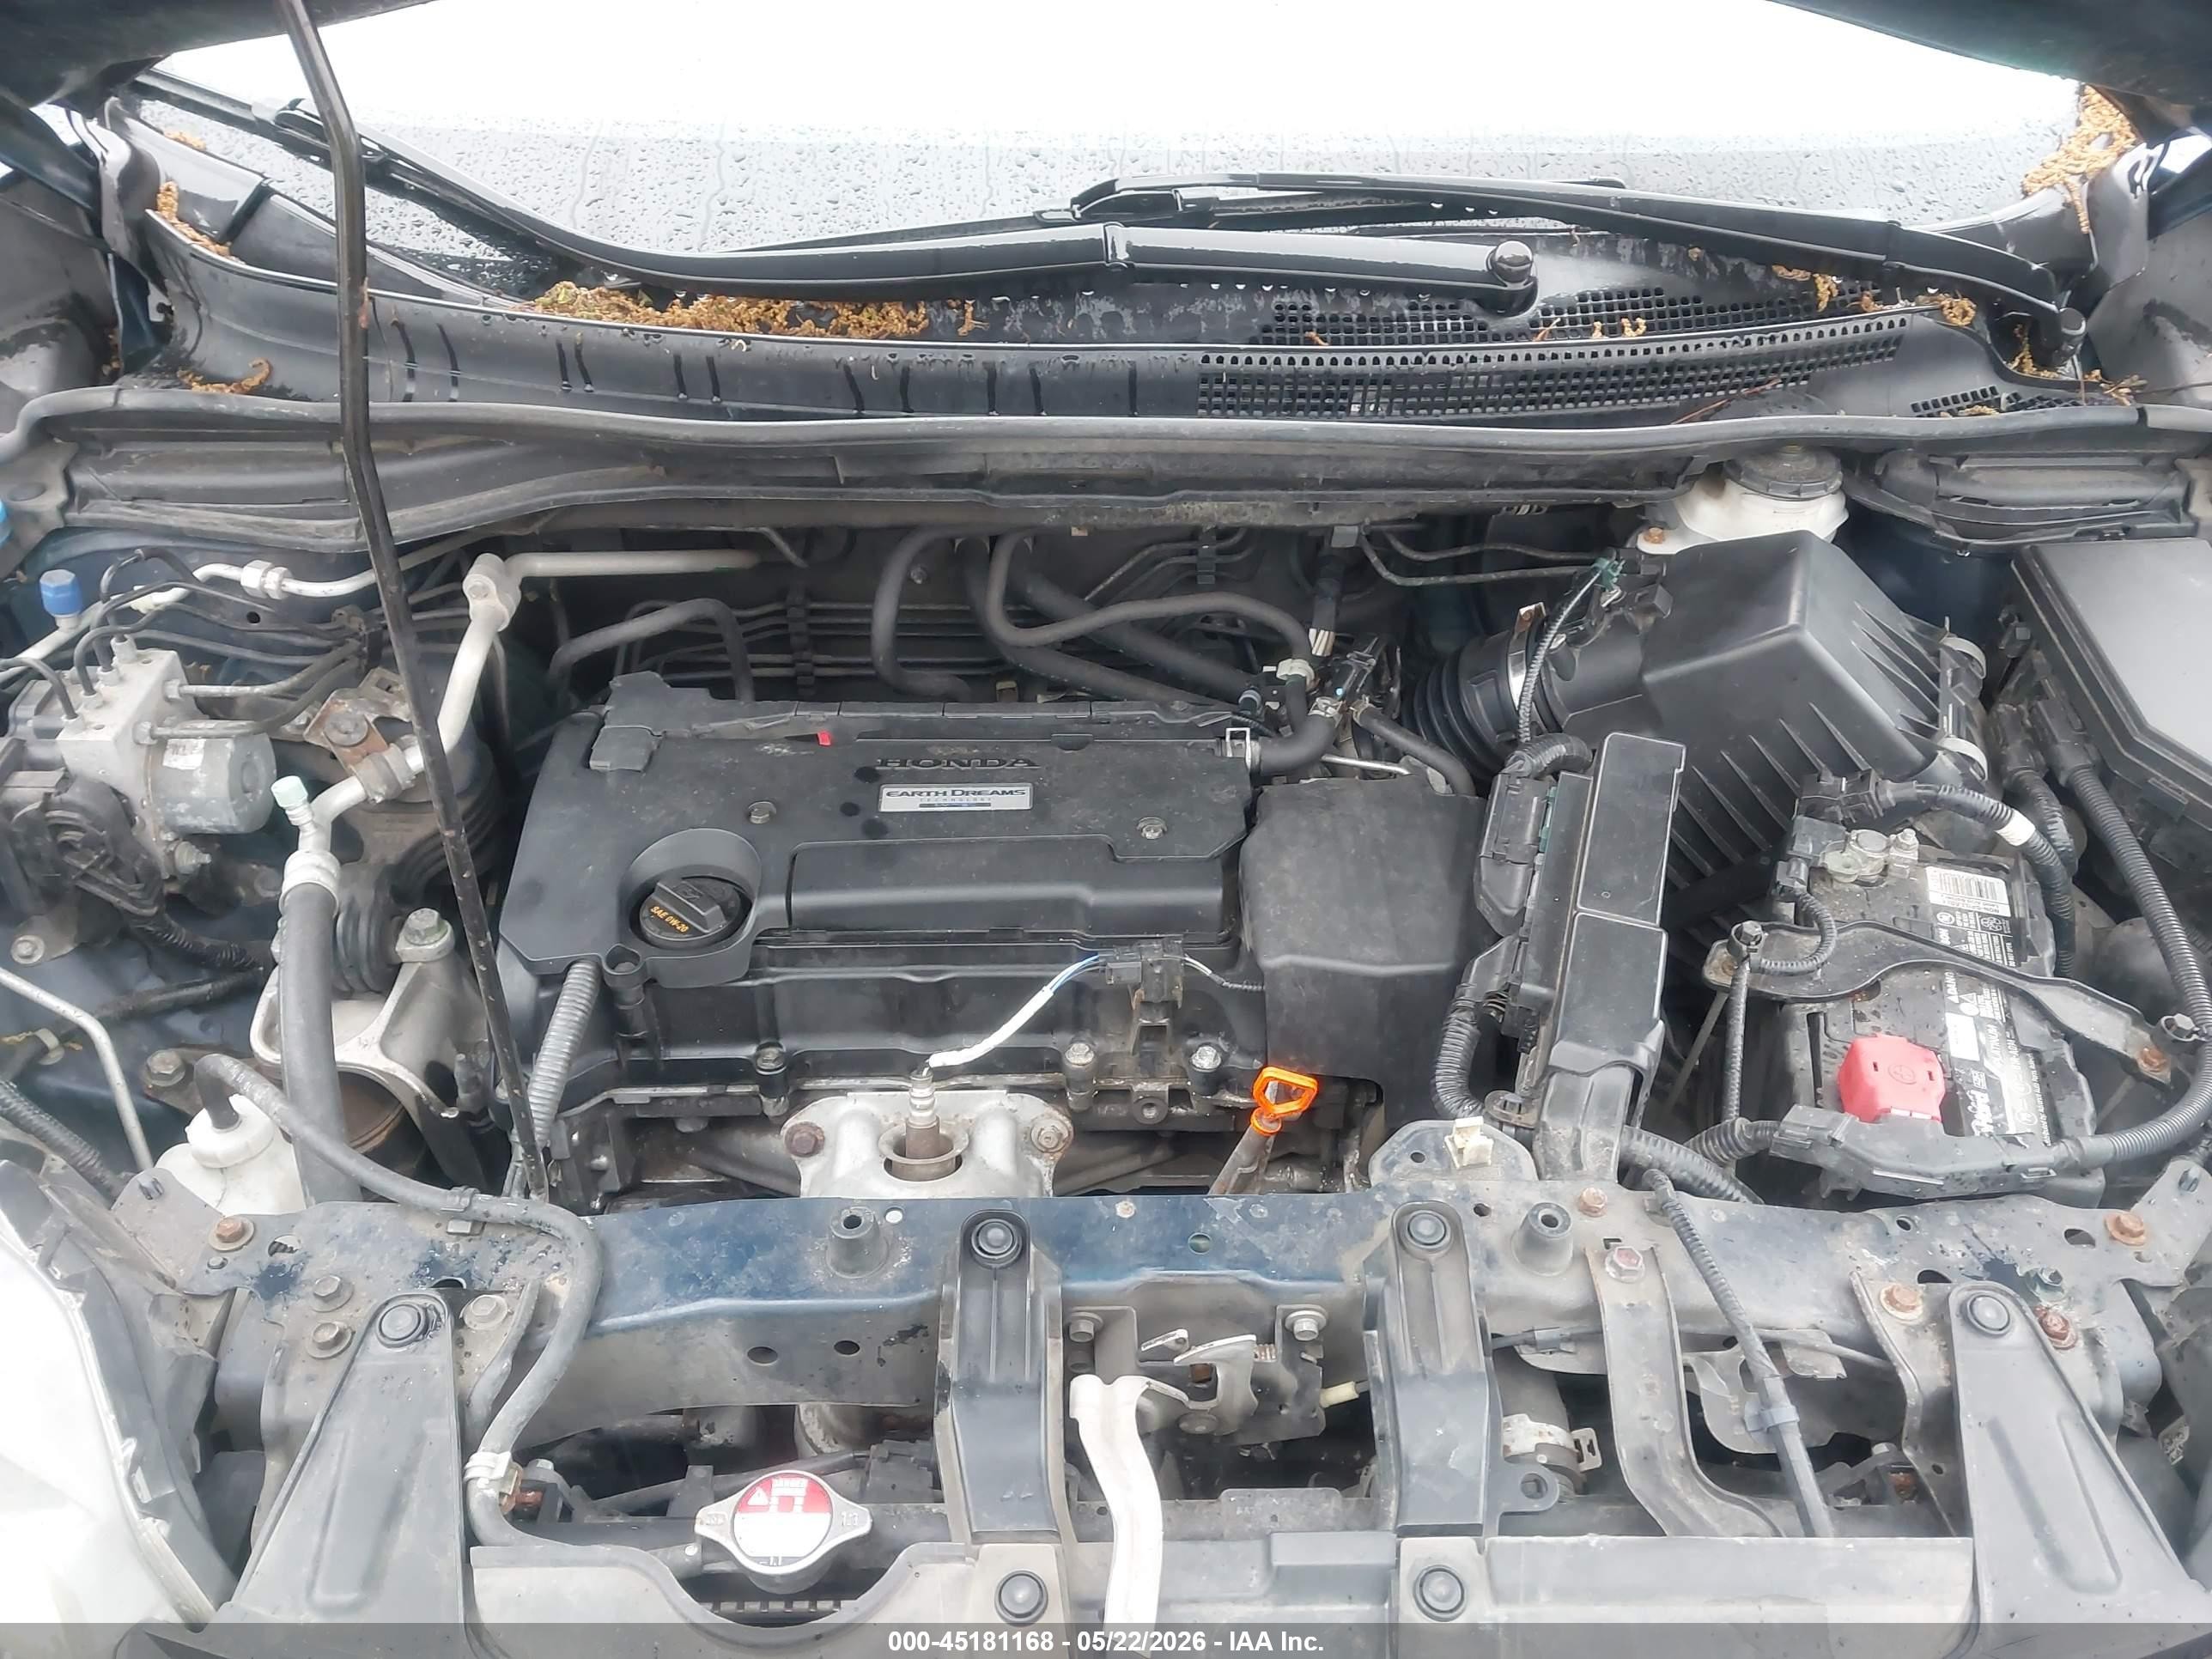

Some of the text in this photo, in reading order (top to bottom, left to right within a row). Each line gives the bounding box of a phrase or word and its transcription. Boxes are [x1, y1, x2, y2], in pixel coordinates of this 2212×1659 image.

[876, 758, 1041, 770] HONDA
[650, 906, 689, 933] SAE 0W-20
